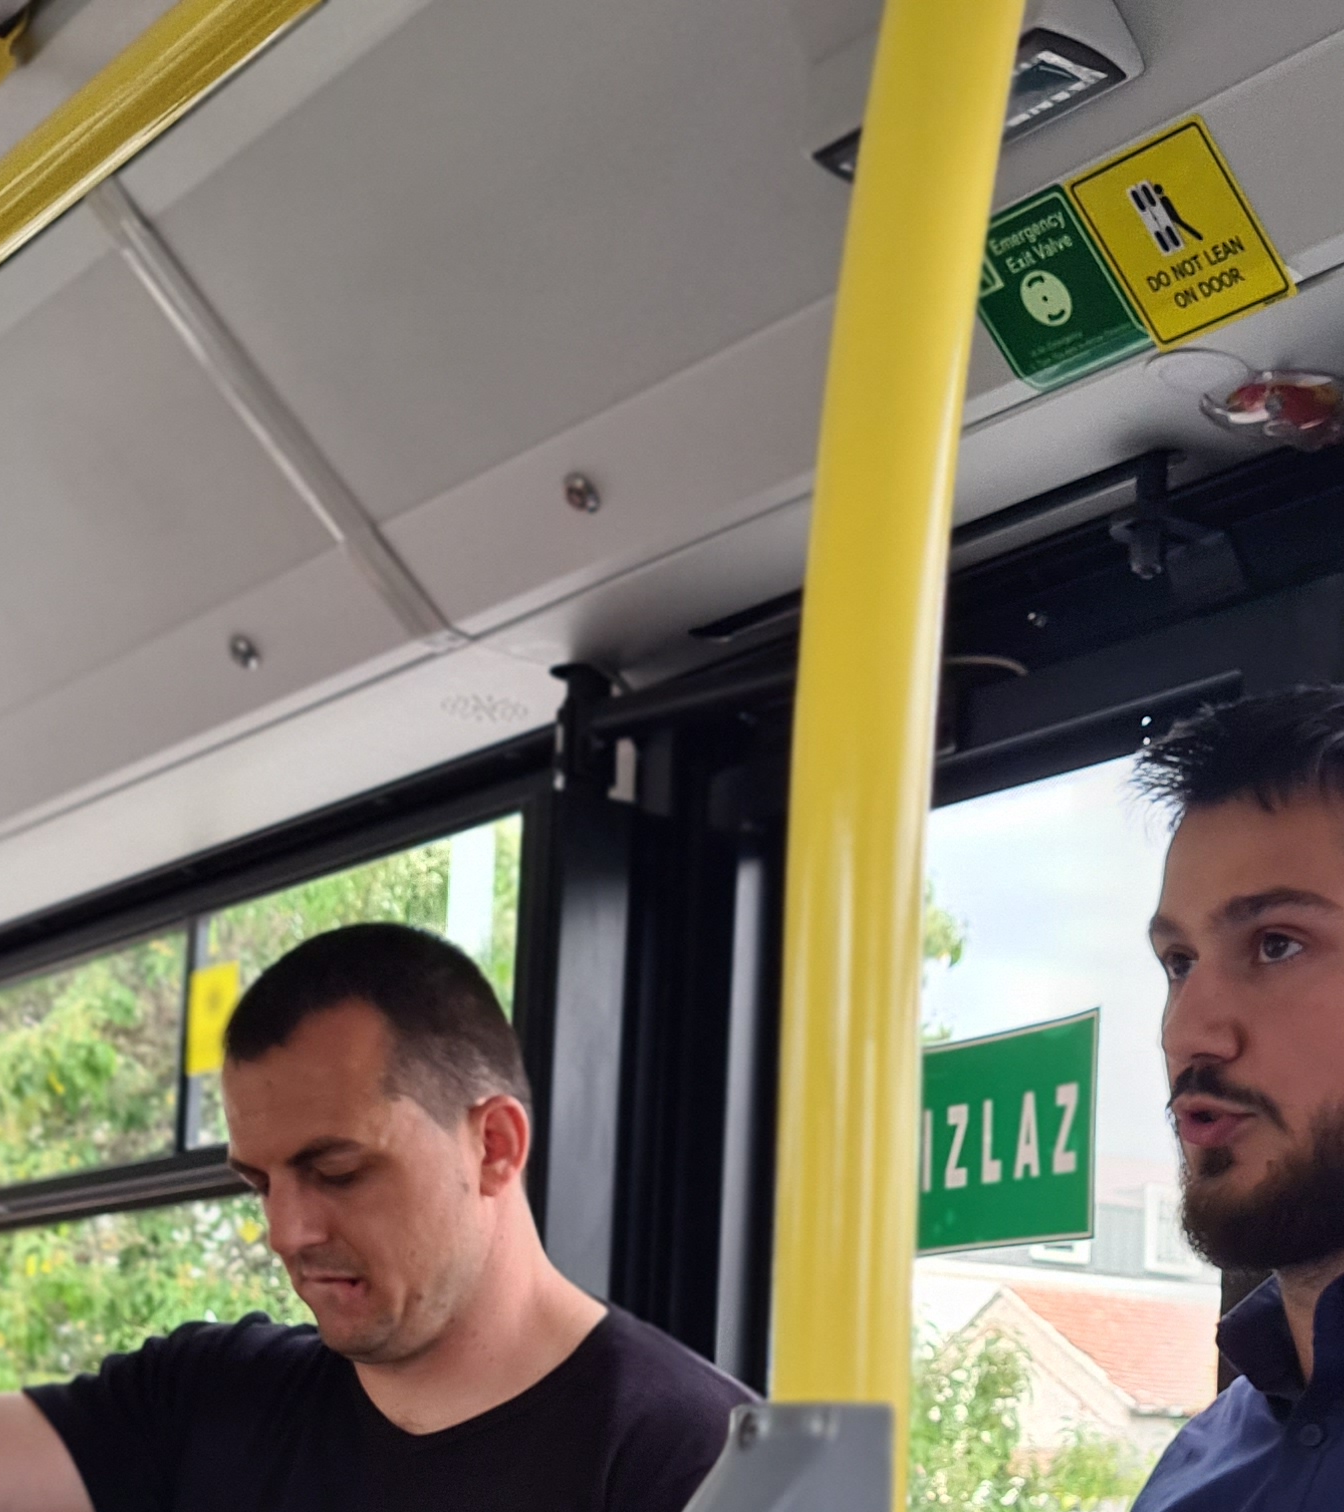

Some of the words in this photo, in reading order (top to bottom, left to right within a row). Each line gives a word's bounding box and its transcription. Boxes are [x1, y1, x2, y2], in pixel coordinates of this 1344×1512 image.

[989, 211, 1066, 256] Emergency
[1006, 250, 1037, 274] Exit
[1032, 234, 1073, 260] Valve
[1146, 270, 1171, 293] DO
[1170, 254, 1203, 281] NOT
[1203, 235, 1245, 266] LEAN
[1174, 286, 1199, 308] ON
[1198, 267, 1246, 298] DOOR
[923, 1082, 1079, 1193] IZLAZ
